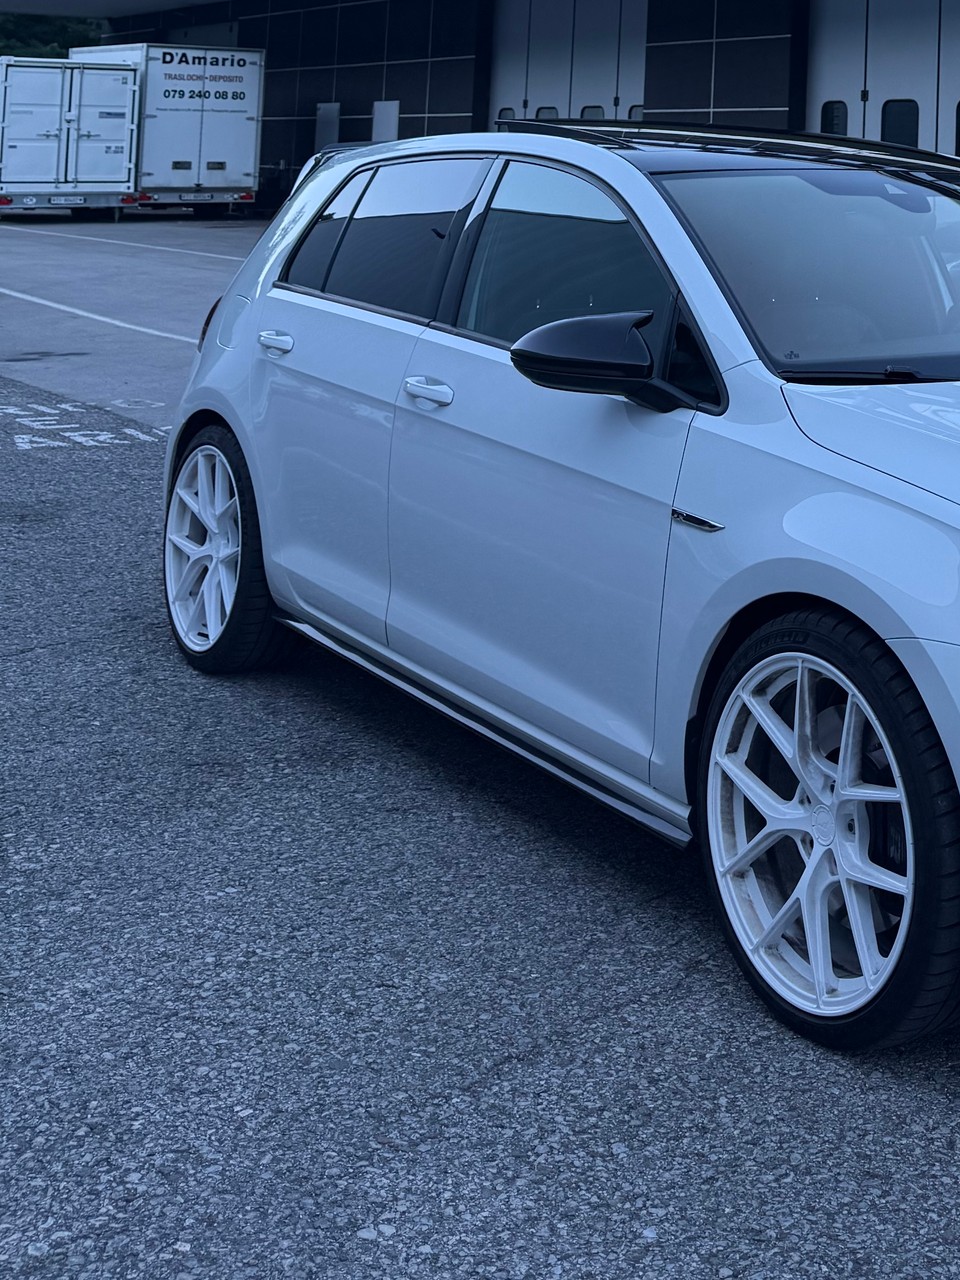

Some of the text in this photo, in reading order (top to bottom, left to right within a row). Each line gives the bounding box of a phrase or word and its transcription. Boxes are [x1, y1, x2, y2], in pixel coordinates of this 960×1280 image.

[162, 51, 247, 68] D'Amario
[163, 89, 246, 101] 079 240 08 80
